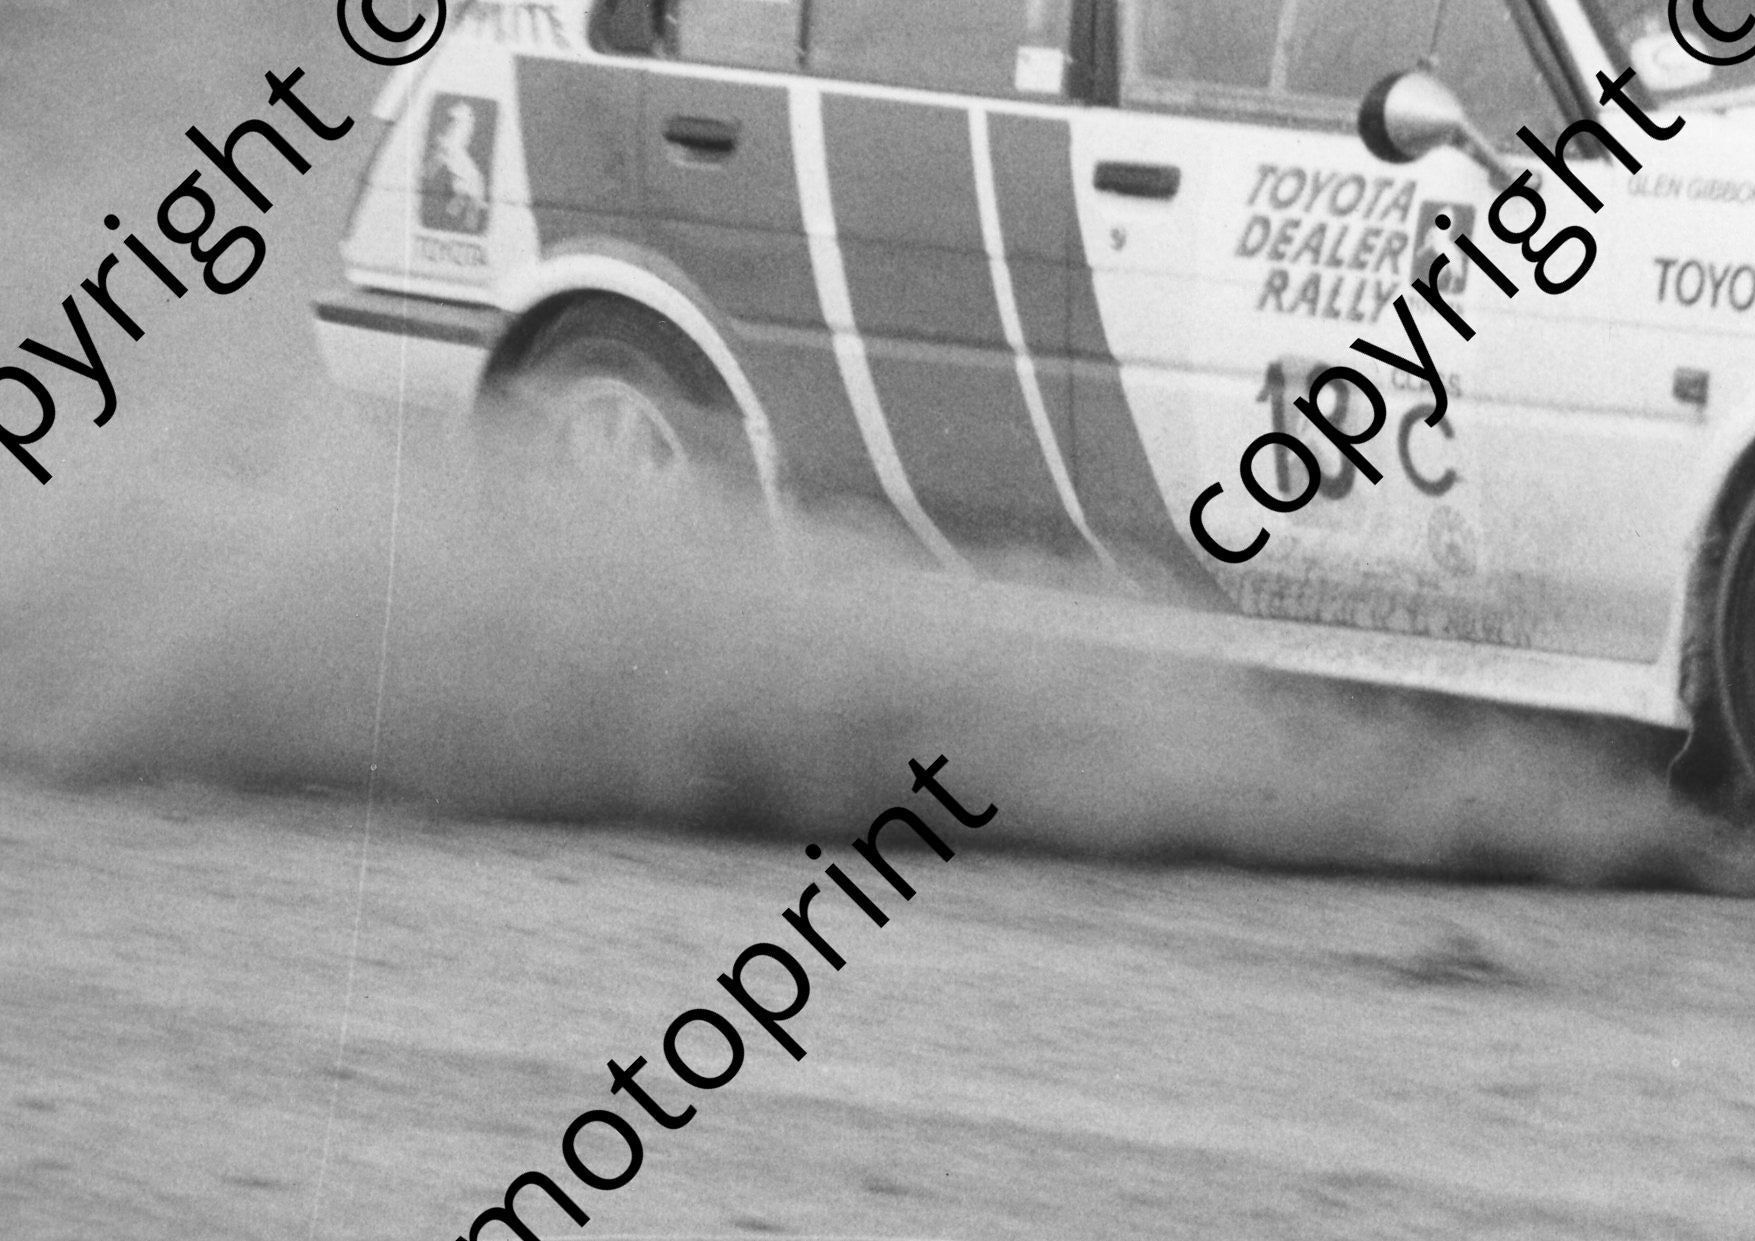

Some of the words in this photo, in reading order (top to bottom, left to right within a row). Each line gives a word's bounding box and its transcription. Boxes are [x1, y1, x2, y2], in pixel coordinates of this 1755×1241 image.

[1249, 163, 1417, 222] TOYOTA
[1235, 214, 1409, 275] DEALER
[1257, 268, 1402, 323] RALLY
[1398, 403, 1456, 497] C
